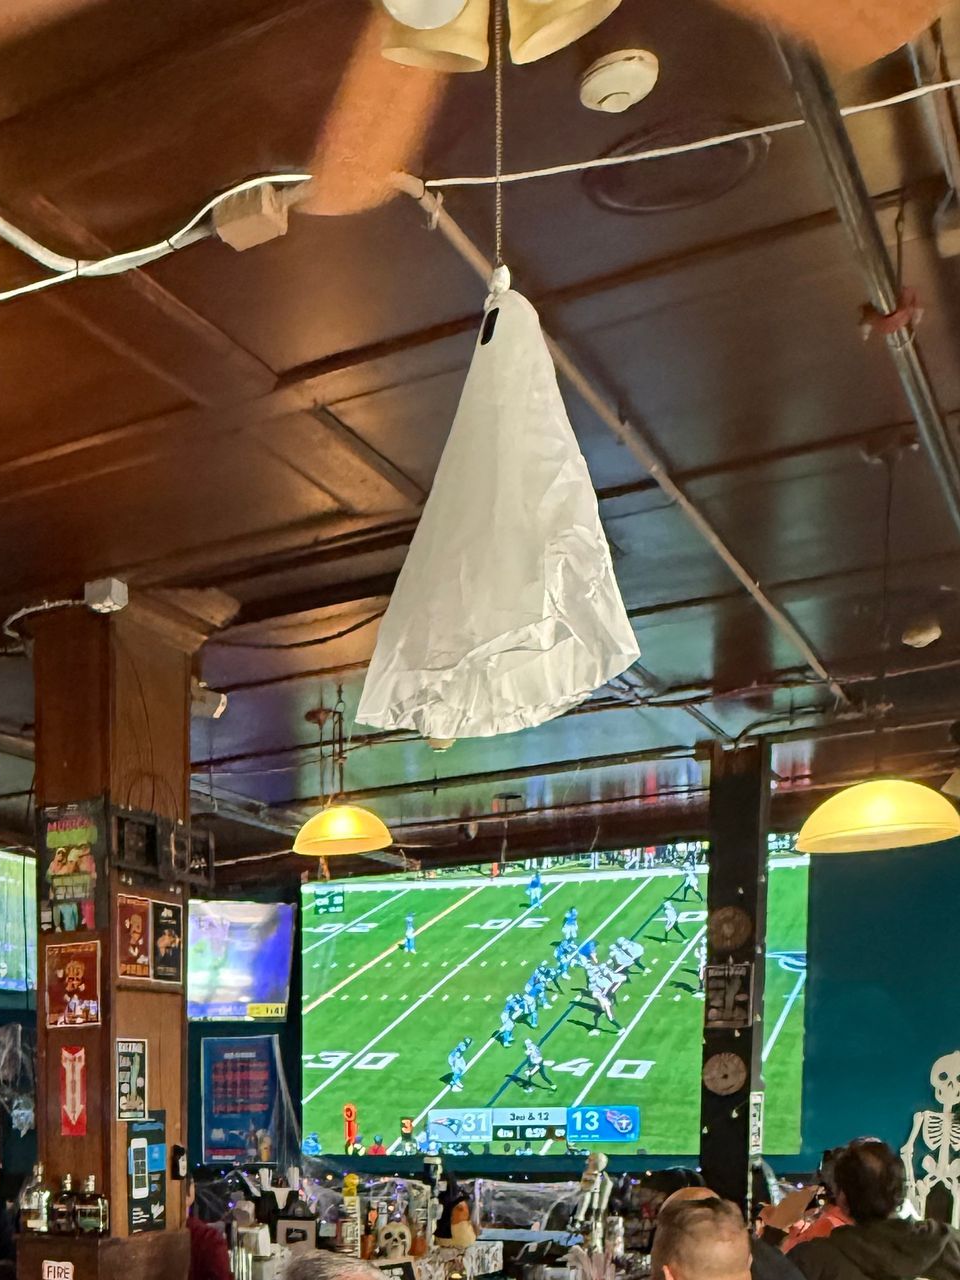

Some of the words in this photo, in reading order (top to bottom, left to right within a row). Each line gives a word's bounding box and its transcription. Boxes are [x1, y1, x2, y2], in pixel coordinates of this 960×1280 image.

[462, 1112, 487, 1132] 31
[537, 1112, 550, 1121] 12
[571, 1110, 600, 1131] 13
[47, 1265, 70, 1279] FIRE
